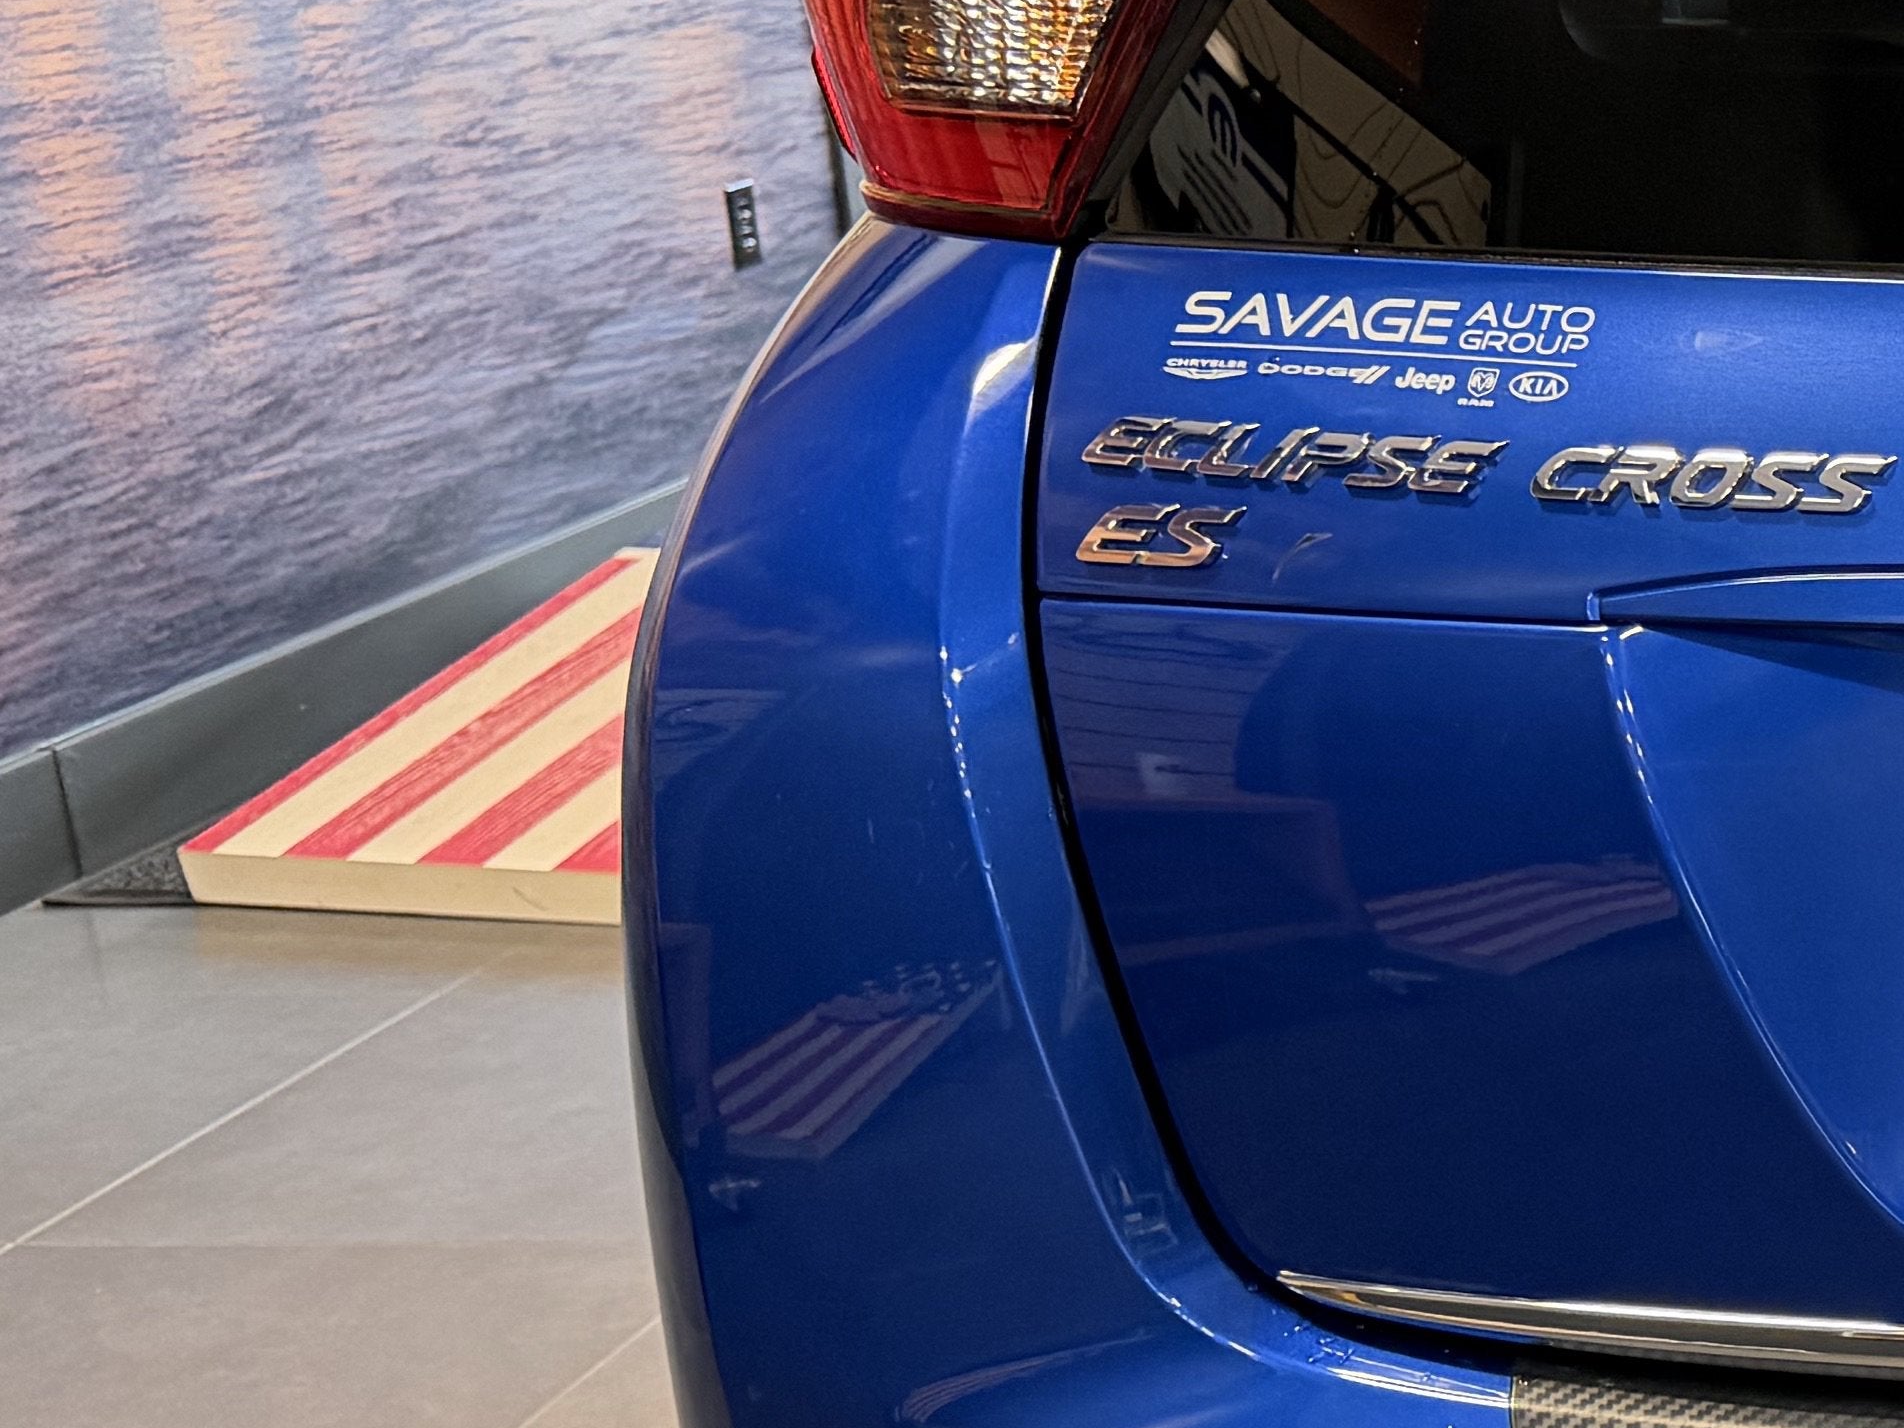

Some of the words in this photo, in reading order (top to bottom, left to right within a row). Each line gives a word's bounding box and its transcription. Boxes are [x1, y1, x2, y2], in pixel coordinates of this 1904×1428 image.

[1175, 291, 1461, 345] SAVAGE
[1465, 301, 1596, 333] AUTO
[1459, 329, 1590, 355] GROUP
[1166, 358, 1248, 369] CHRYSLER
[1257, 362, 1372, 378] DODGE
[1395, 367, 1456, 395] Jeep
[1518, 379, 1559, 399] KIA
[1457, 397, 1495, 407] RAM
[1082, 417, 1510, 494] ECLIPSE
[1530, 445, 1899, 515] CROSS
[1075, 504, 1248, 568] ES
